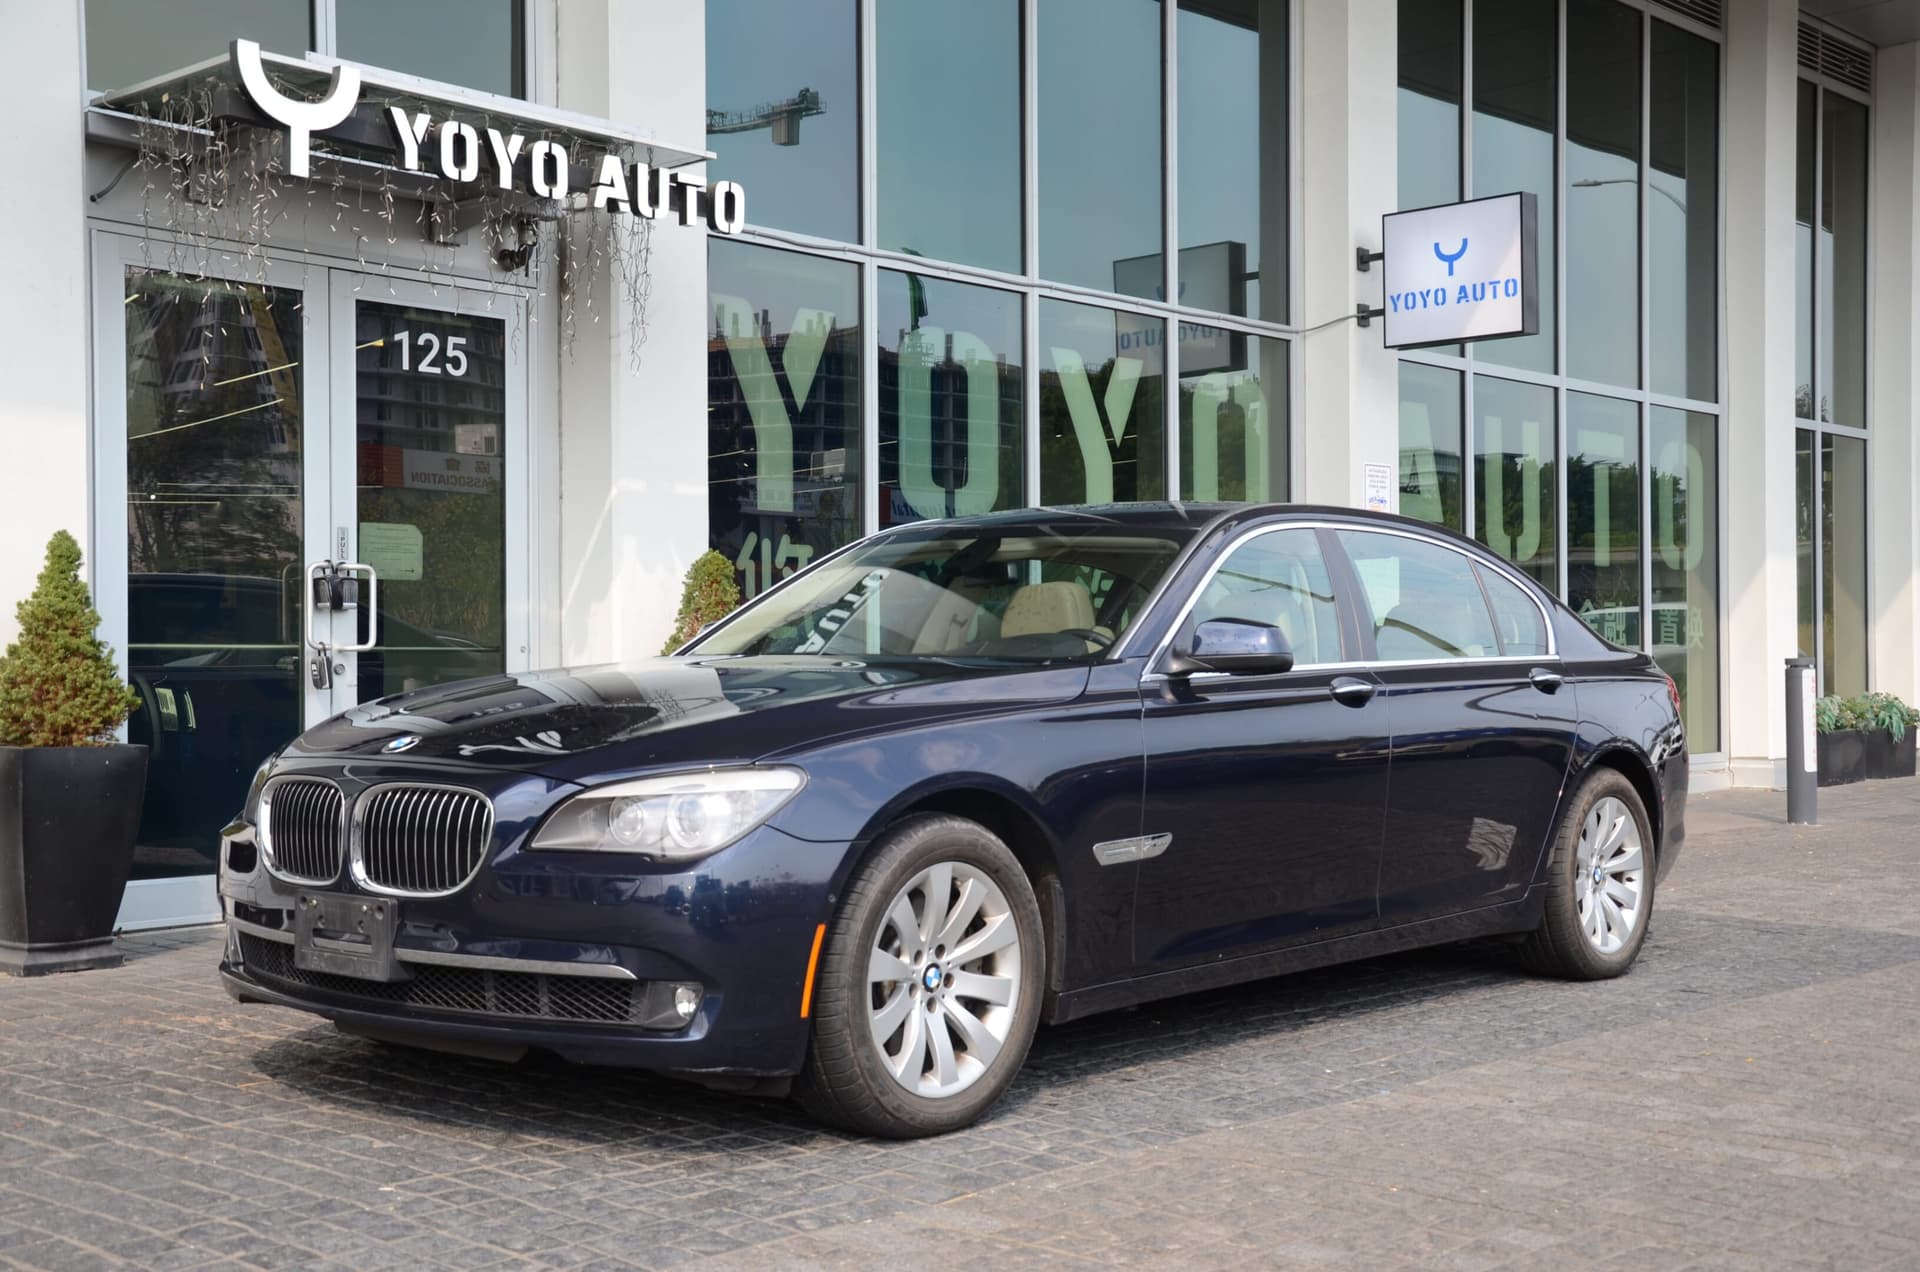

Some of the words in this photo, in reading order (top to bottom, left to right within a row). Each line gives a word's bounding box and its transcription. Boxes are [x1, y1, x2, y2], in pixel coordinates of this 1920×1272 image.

[386, 105, 569, 200] YOYO
[593, 154, 745, 234] AUTO
[1389, 287, 1447, 313] YOYO
[1456, 278, 1518, 304] AUTO
[393, 330, 468, 377] 125
[710, 292, 1269, 519] YOYO
